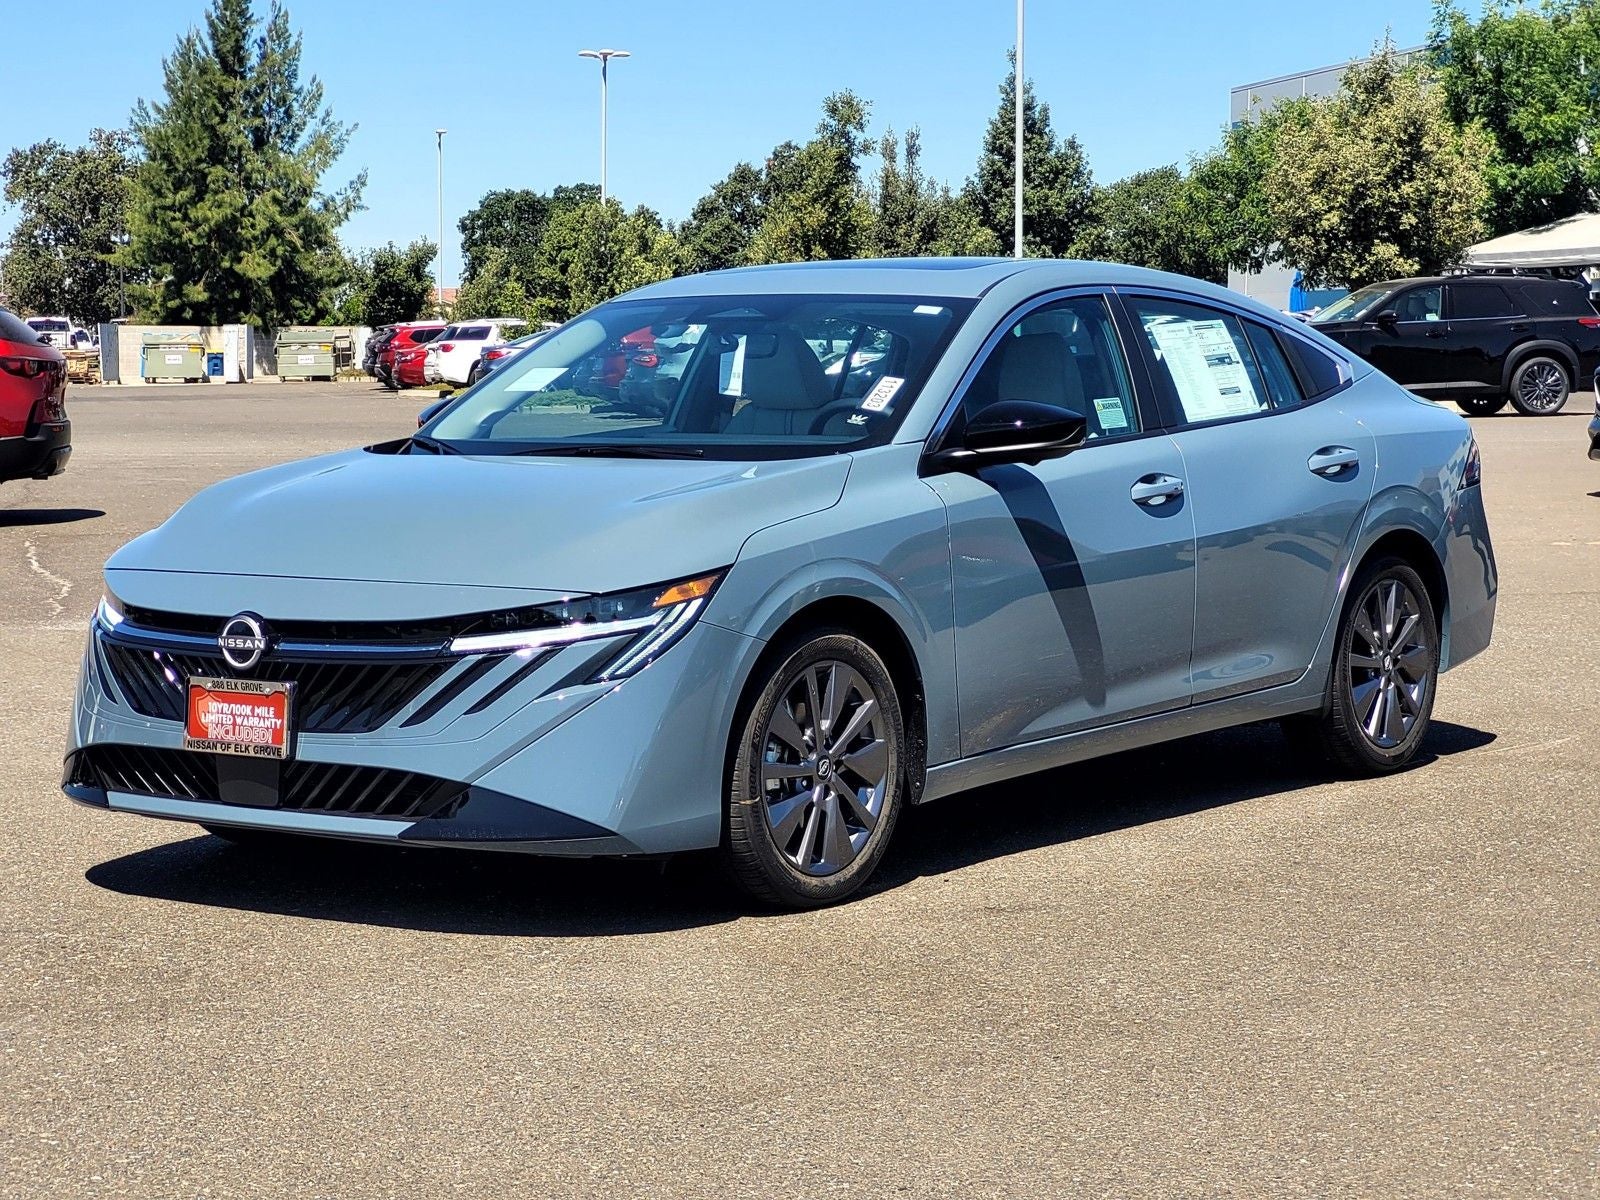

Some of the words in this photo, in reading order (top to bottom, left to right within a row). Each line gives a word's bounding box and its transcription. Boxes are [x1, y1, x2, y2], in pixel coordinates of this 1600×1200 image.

[218, 637, 264, 649] NISSAN
[226, 681, 240, 691] ELK
[241, 682, 263, 692] GROVE
[208, 702, 251, 715] 10YR/100K
[254, 705, 275, 718] MILE
[201, 713, 233, 725] LIMITED
[235, 715, 282, 730] WARRANTY
[207, 724, 273, 743] INCLUDED!
[187, 740, 218, 751] NISSAN
[220, 742, 232, 752] OF
[235, 744, 251, 754] ELK
[253, 746, 282, 757] GROVE
